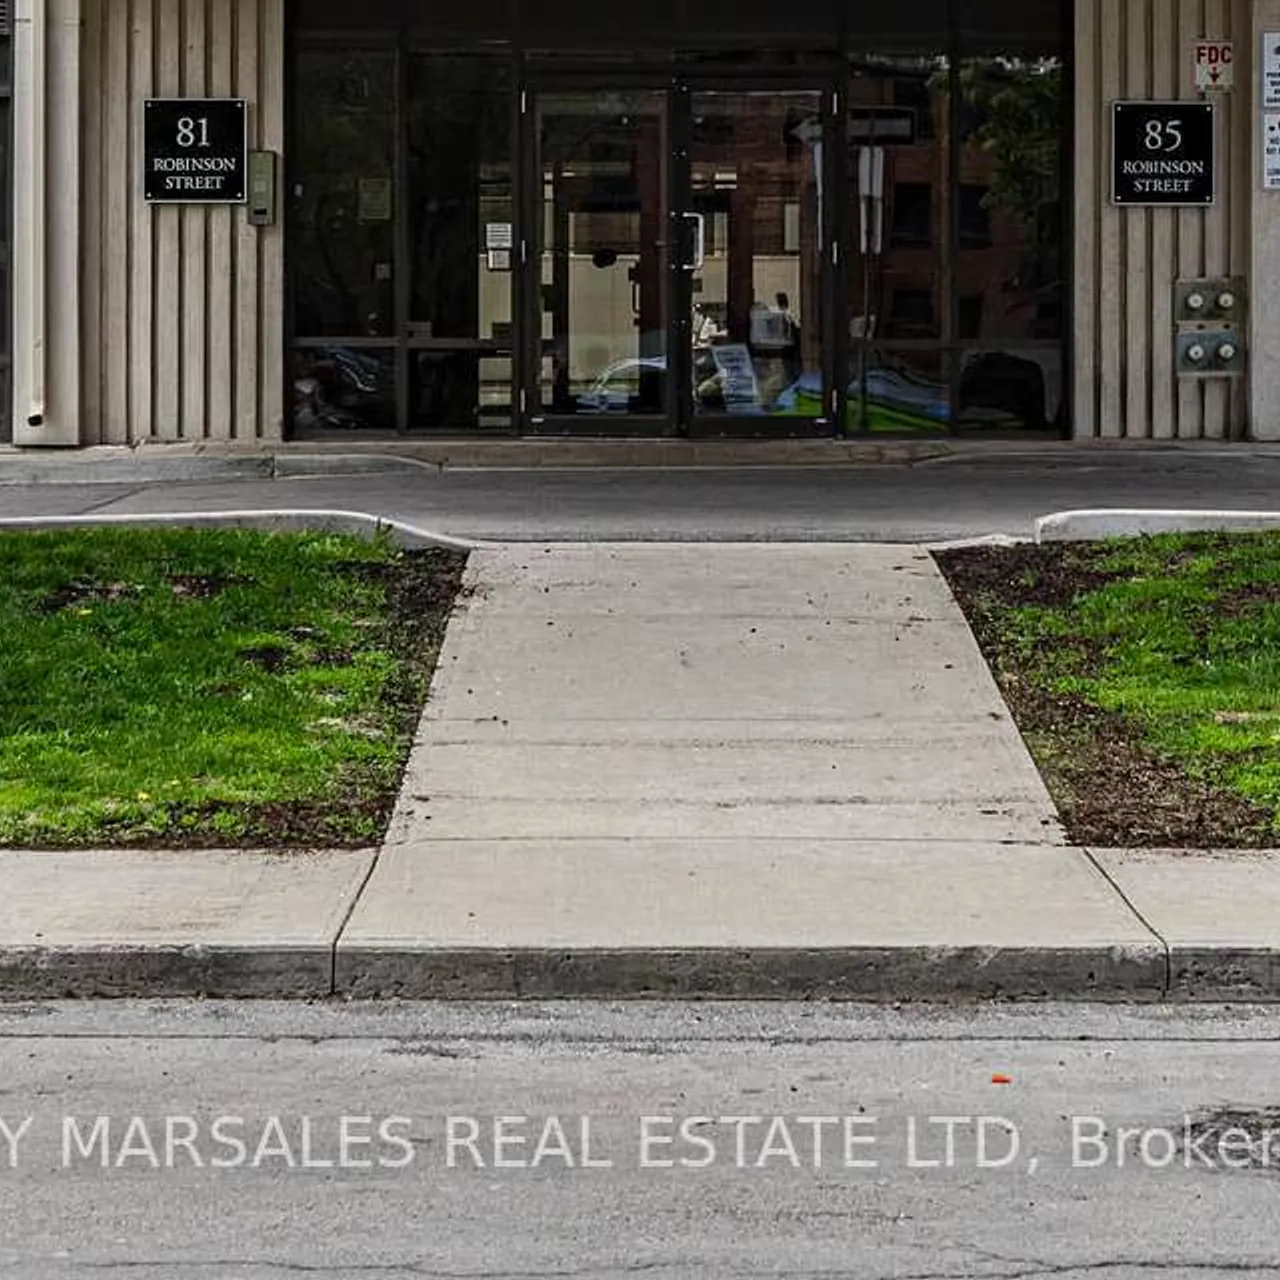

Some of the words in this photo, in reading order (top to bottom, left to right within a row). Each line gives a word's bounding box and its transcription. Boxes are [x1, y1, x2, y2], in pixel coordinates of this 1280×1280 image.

[1196, 46, 1232, 64] FDC
[176, 118, 210, 147] 81
[1144, 120, 1182, 152] 85
[153, 157, 236, 171] ROBINSON
[1123, 160, 1204, 174] ROBINSON
[165, 176, 224, 189] STREET
[1134, 179, 1193, 192] STREET
